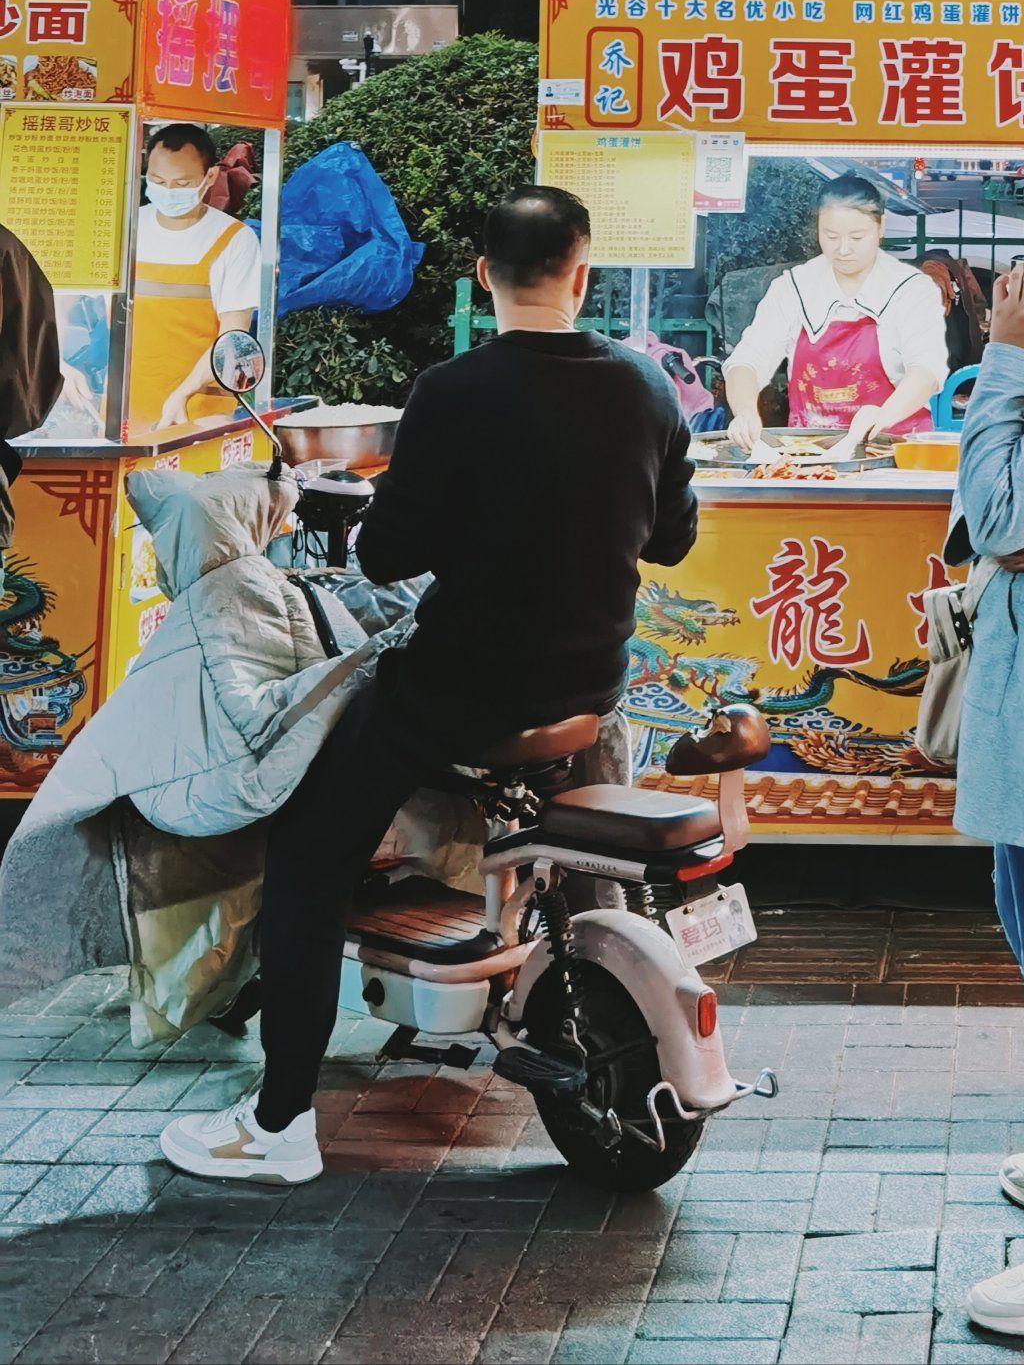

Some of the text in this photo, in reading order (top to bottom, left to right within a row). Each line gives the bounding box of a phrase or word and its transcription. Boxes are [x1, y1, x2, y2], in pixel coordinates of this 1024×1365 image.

[854, 1, 1022, 24] 网红鸡蛋灌饼
[596, 40, 632, 113] 乔记
[22, 115, 111, 132] 摇摆哥炒饭
[597, 136, 641, 148] 鸡蛋灌饼
[96, 188, 114, 196] 10元
[95, 198, 113, 206] 10元
[94, 209, 112, 217] 10元
[94, 219, 112, 227] 12元
[681, 916, 722, 948] 爱玛
